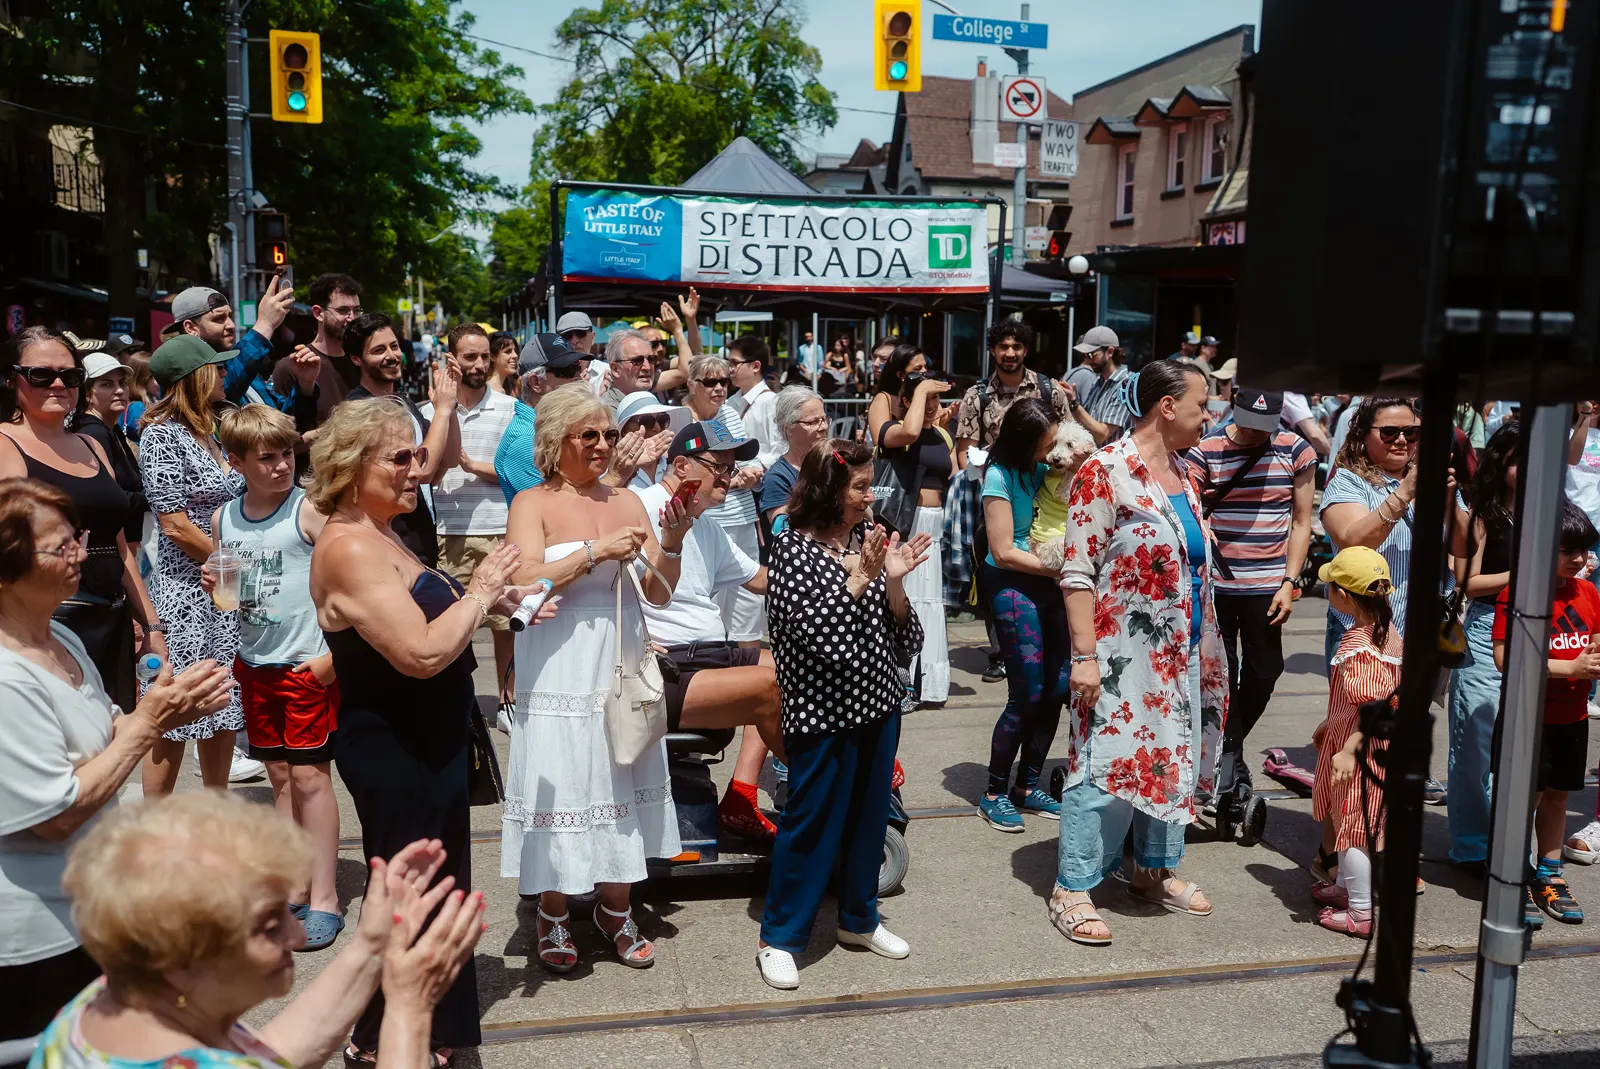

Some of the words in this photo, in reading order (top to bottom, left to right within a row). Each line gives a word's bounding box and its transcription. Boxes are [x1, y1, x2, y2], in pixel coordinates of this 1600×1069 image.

[952, 17, 1013, 44] College
[1047, 122, 1075, 139] TWO
[1045, 142, 1075, 158] WAY
[1043, 160, 1074, 174] TRAFFIC
[583, 203, 640, 220] TASTE
[641, 206, 665, 223] OF
[584, 221, 628, 235] LITTLE
[629, 224, 663, 237] ITALY
[700, 211, 913, 242] SPETTACOLO
[931, 233, 968, 261] TD
[604, 255, 625, 263] LITTLE
[699, 244, 730, 270] DI
[741, 243, 913, 279] STRADA
[227, 540, 244, 549] NEW
[1549, 632, 1589, 650] dida
